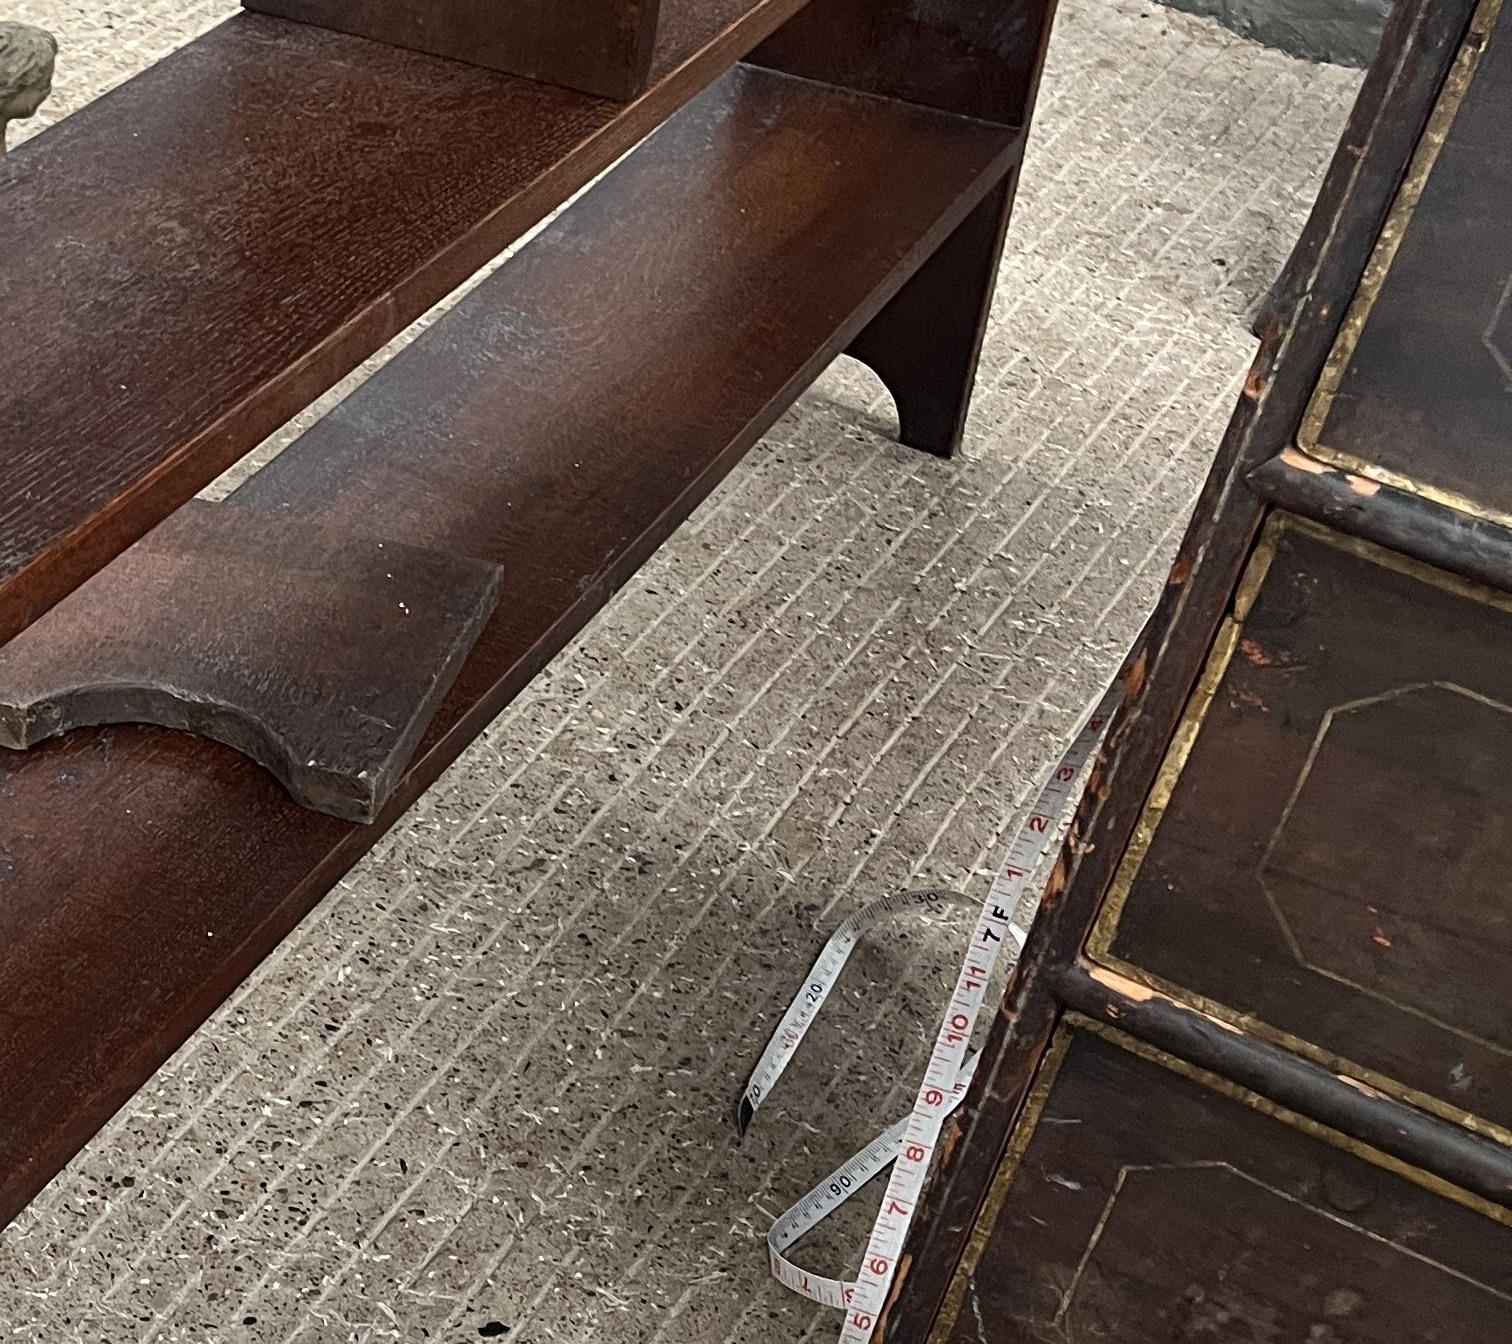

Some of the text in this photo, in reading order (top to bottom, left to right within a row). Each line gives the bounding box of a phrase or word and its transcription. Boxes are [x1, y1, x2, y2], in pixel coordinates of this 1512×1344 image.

[806, 984, 823, 1003] 20
[913, 892, 939, 905] 30
[853, 1313, 871, 1331] 5
[870, 1258, 888, 1275] 6
[888, 1201, 908, 1216] 7
[907, 1146, 925, 1163] 8
[926, 1090, 943, 1107] 9
[947, 1014, 969, 1042] 10
[965, 966, 986, 991] 11
[1007, 868, 1023, 878] 1
[1030, 816, 1049, 833] 2
[1057, 767, 1075, 782] 3
[830, 1175, 852, 1197] 90
